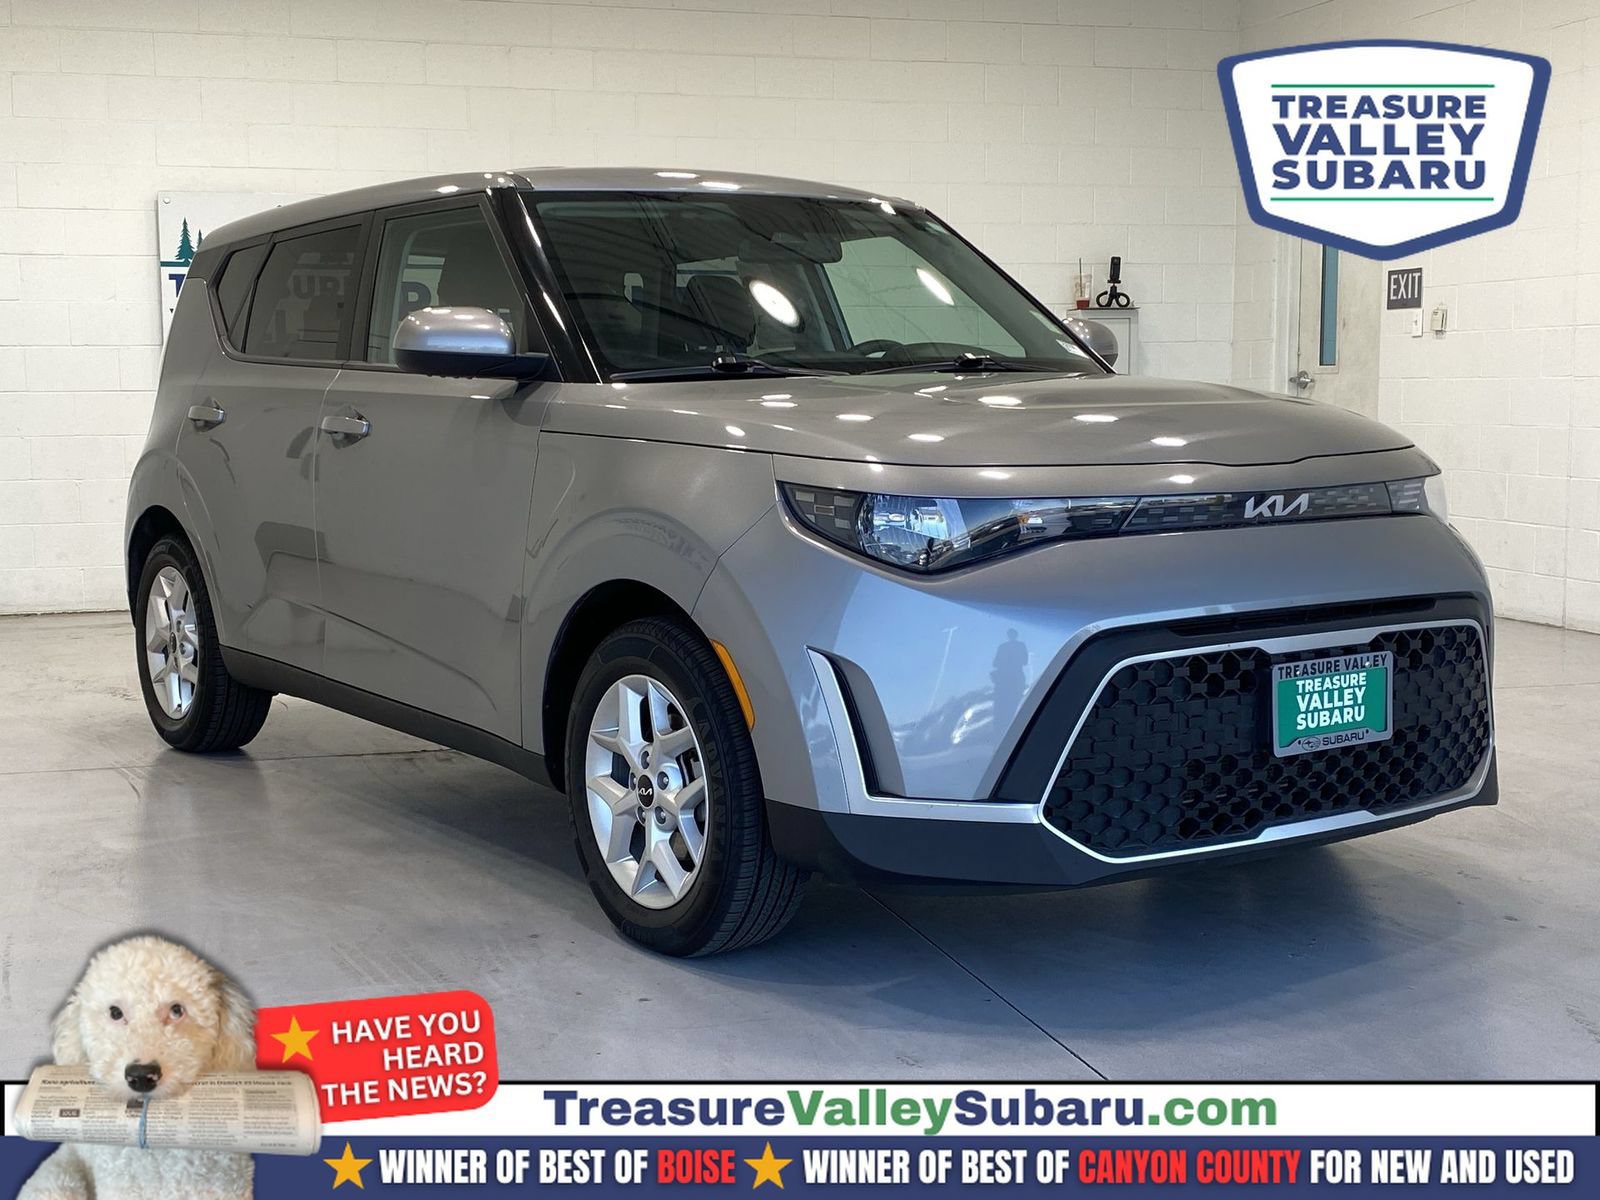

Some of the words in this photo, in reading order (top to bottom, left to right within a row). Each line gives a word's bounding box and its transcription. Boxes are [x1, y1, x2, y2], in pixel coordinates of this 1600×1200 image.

[1390, 272, 1421, 300] EXIT
[1244, 493, 1309, 518] KIA
[1278, 660, 1340, 680] TREASURE
[1344, 654, 1387, 671] VALLEY
[1296, 672, 1367, 694] TREASURE
[1296, 686, 1366, 713] VALLEY
[1296, 705, 1365, 731] SUBARU
[1322, 731, 1365, 746] SUBARU
